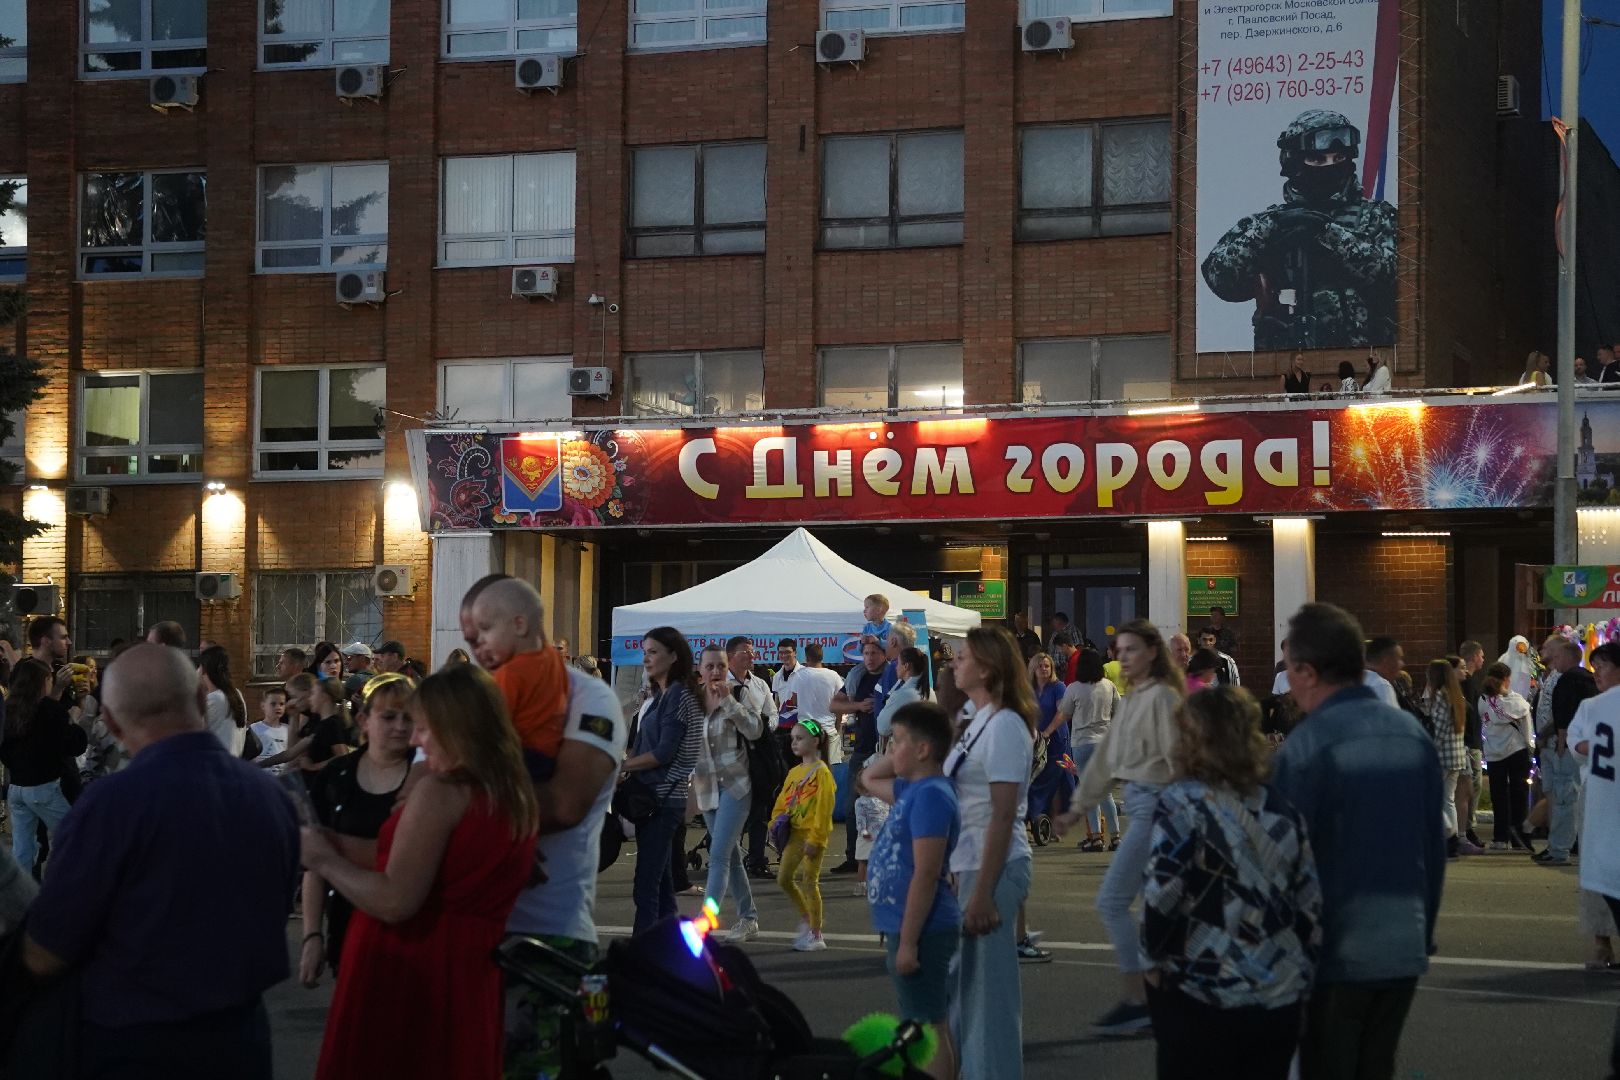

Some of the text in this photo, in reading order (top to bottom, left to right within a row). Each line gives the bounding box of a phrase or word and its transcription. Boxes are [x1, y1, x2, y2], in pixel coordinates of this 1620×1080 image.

[1214, 3, 1282, 14] Электрогорск
[1285, 0, 1346, 9] Московской
[1228, 11, 1336, 26] г. Павловский Посад,
[1220, 22, 1343, 41] пер. Дзержинского, д.6
[1201, 49, 1364, 80] +7 (49643) 2-25-43
[1201, 76, 1364, 106] +7 (926) 760-93-75
[745, 431, 975, 499] Днём
[1004, 420, 1331, 508] города!
